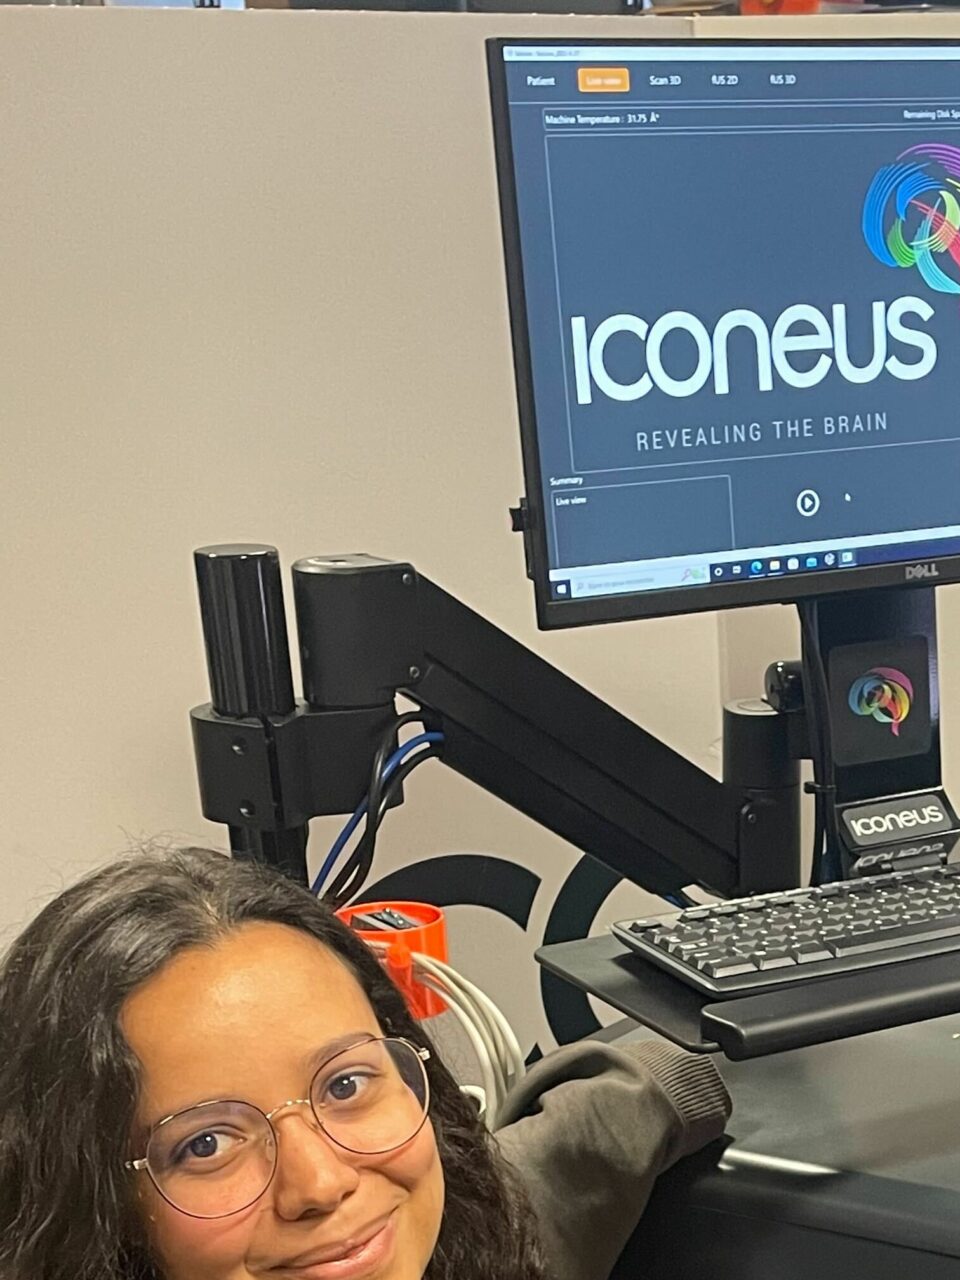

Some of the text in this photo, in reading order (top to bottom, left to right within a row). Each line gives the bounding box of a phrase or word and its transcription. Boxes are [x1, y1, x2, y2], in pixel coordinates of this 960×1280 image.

[526, 75, 555, 86] Patient
[649, 75, 668, 86] Scan
[545, 114, 576, 125] Machine
[636, 412, 888, 451] REVEALING THE BRAIN
[550, 477, 584, 486] Summary
[555, 497, 570, 506] Live
[905, 563, 939, 580] DELL
